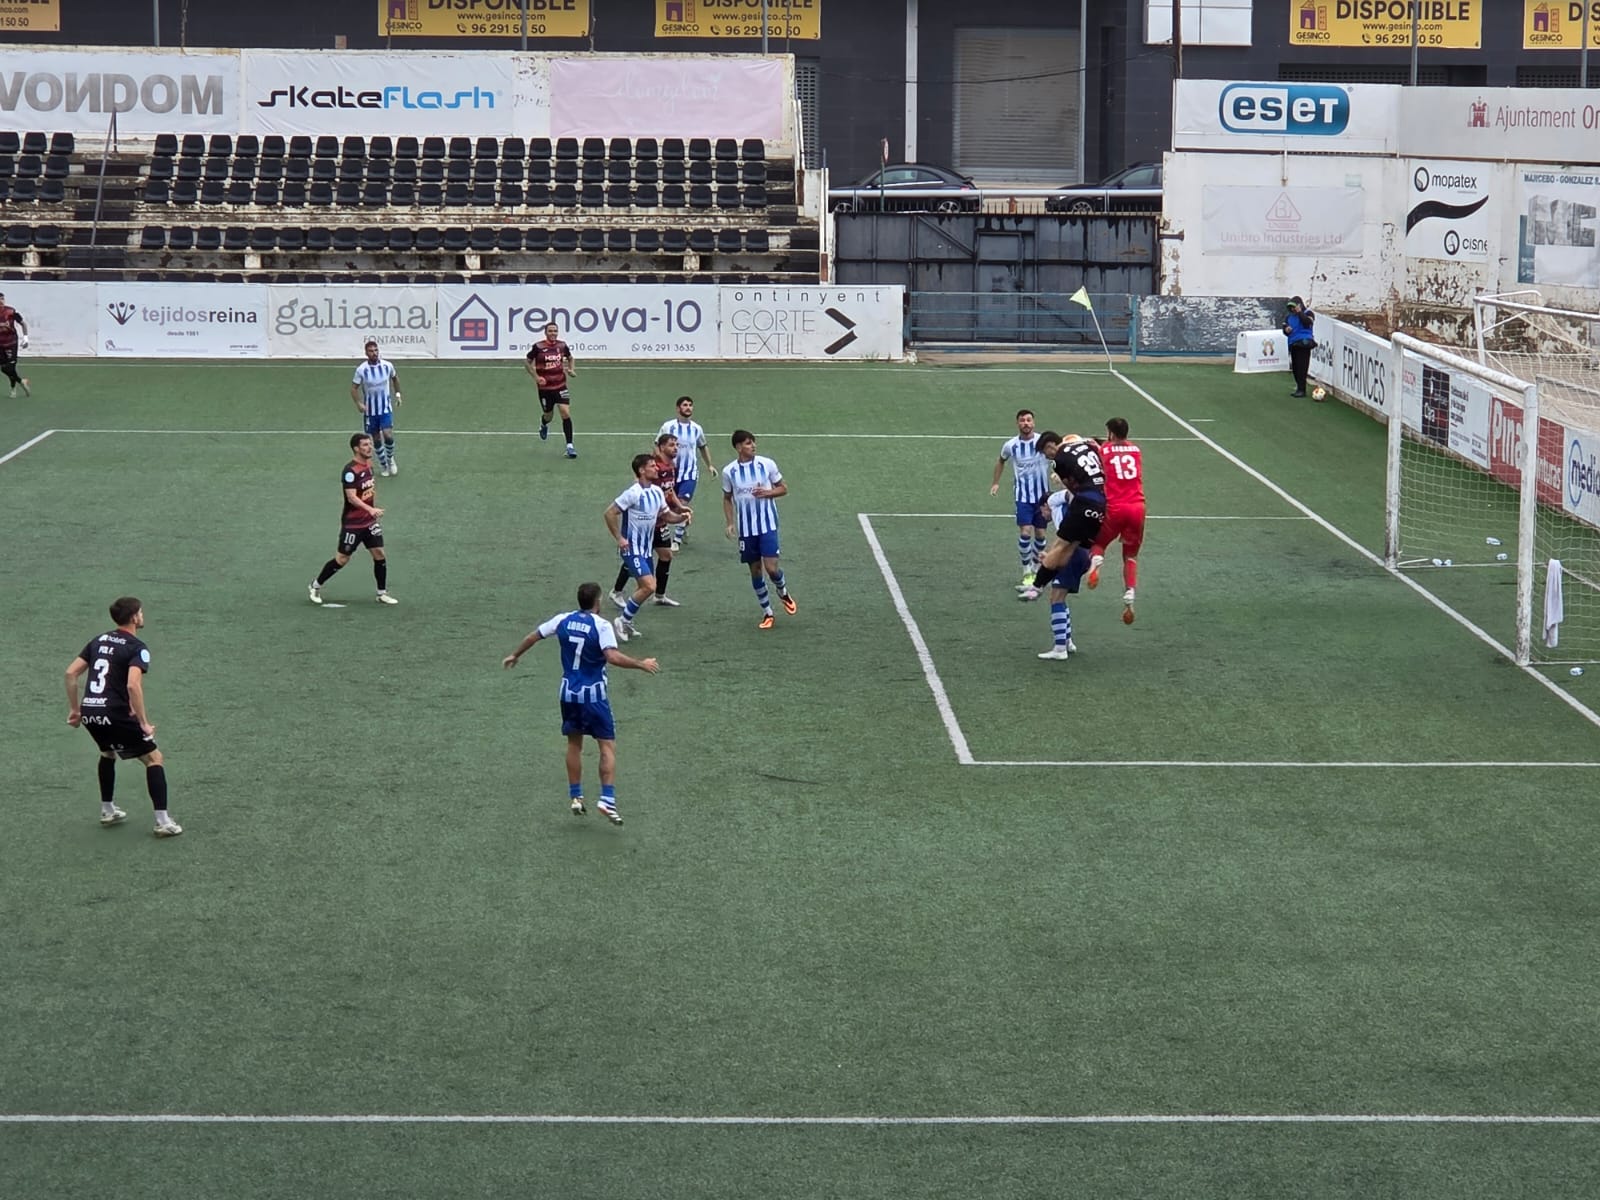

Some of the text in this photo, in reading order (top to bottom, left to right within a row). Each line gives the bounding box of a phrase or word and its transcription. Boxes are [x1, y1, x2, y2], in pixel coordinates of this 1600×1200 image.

[1336, 2, 1470, 21] DISPONIBLE
[472, 24, 486, 34] 96
[490, 24, 509, 34] 291
[531, 24, 546, 34] 50
[662, 24, 700, 32] GESINCO
[725, 26, 740, 35] 96
[768, 26, 782, 35] 50
[1296, 31, 1331, 40] GESINCO
[1375, 34, 1389, 44] 96
[1392, 34, 1409, 44] 291
[1430, 34, 1443, 44] 50
[1529, 34, 1563, 42] GESINCO
[1495, 105, 1576, 133] Ajuntament
[1431, 173, 1477, 189] mopatex
[1560, 175, 1594, 185] GONZALEZ
[1263, 232, 1321, 245] Industries
[734, 289, 881, 304] ontinyent
[275, 297, 432, 336] galiana
[508, 299, 701, 333] renova-10
[731, 309, 815, 332] CORTE
[641, 343, 696, 353] 96 291 3635
[731, 332, 803, 355] TEXTIL
[1342, 345, 1386, 405] FRANCÉS
[1110, 454, 1138, 480] 13
[344, 532, 356, 546] 10
[633, 557, 641, 569] 8
[568, 635, 586, 670] 7
[90, 658, 110, 694] 3
